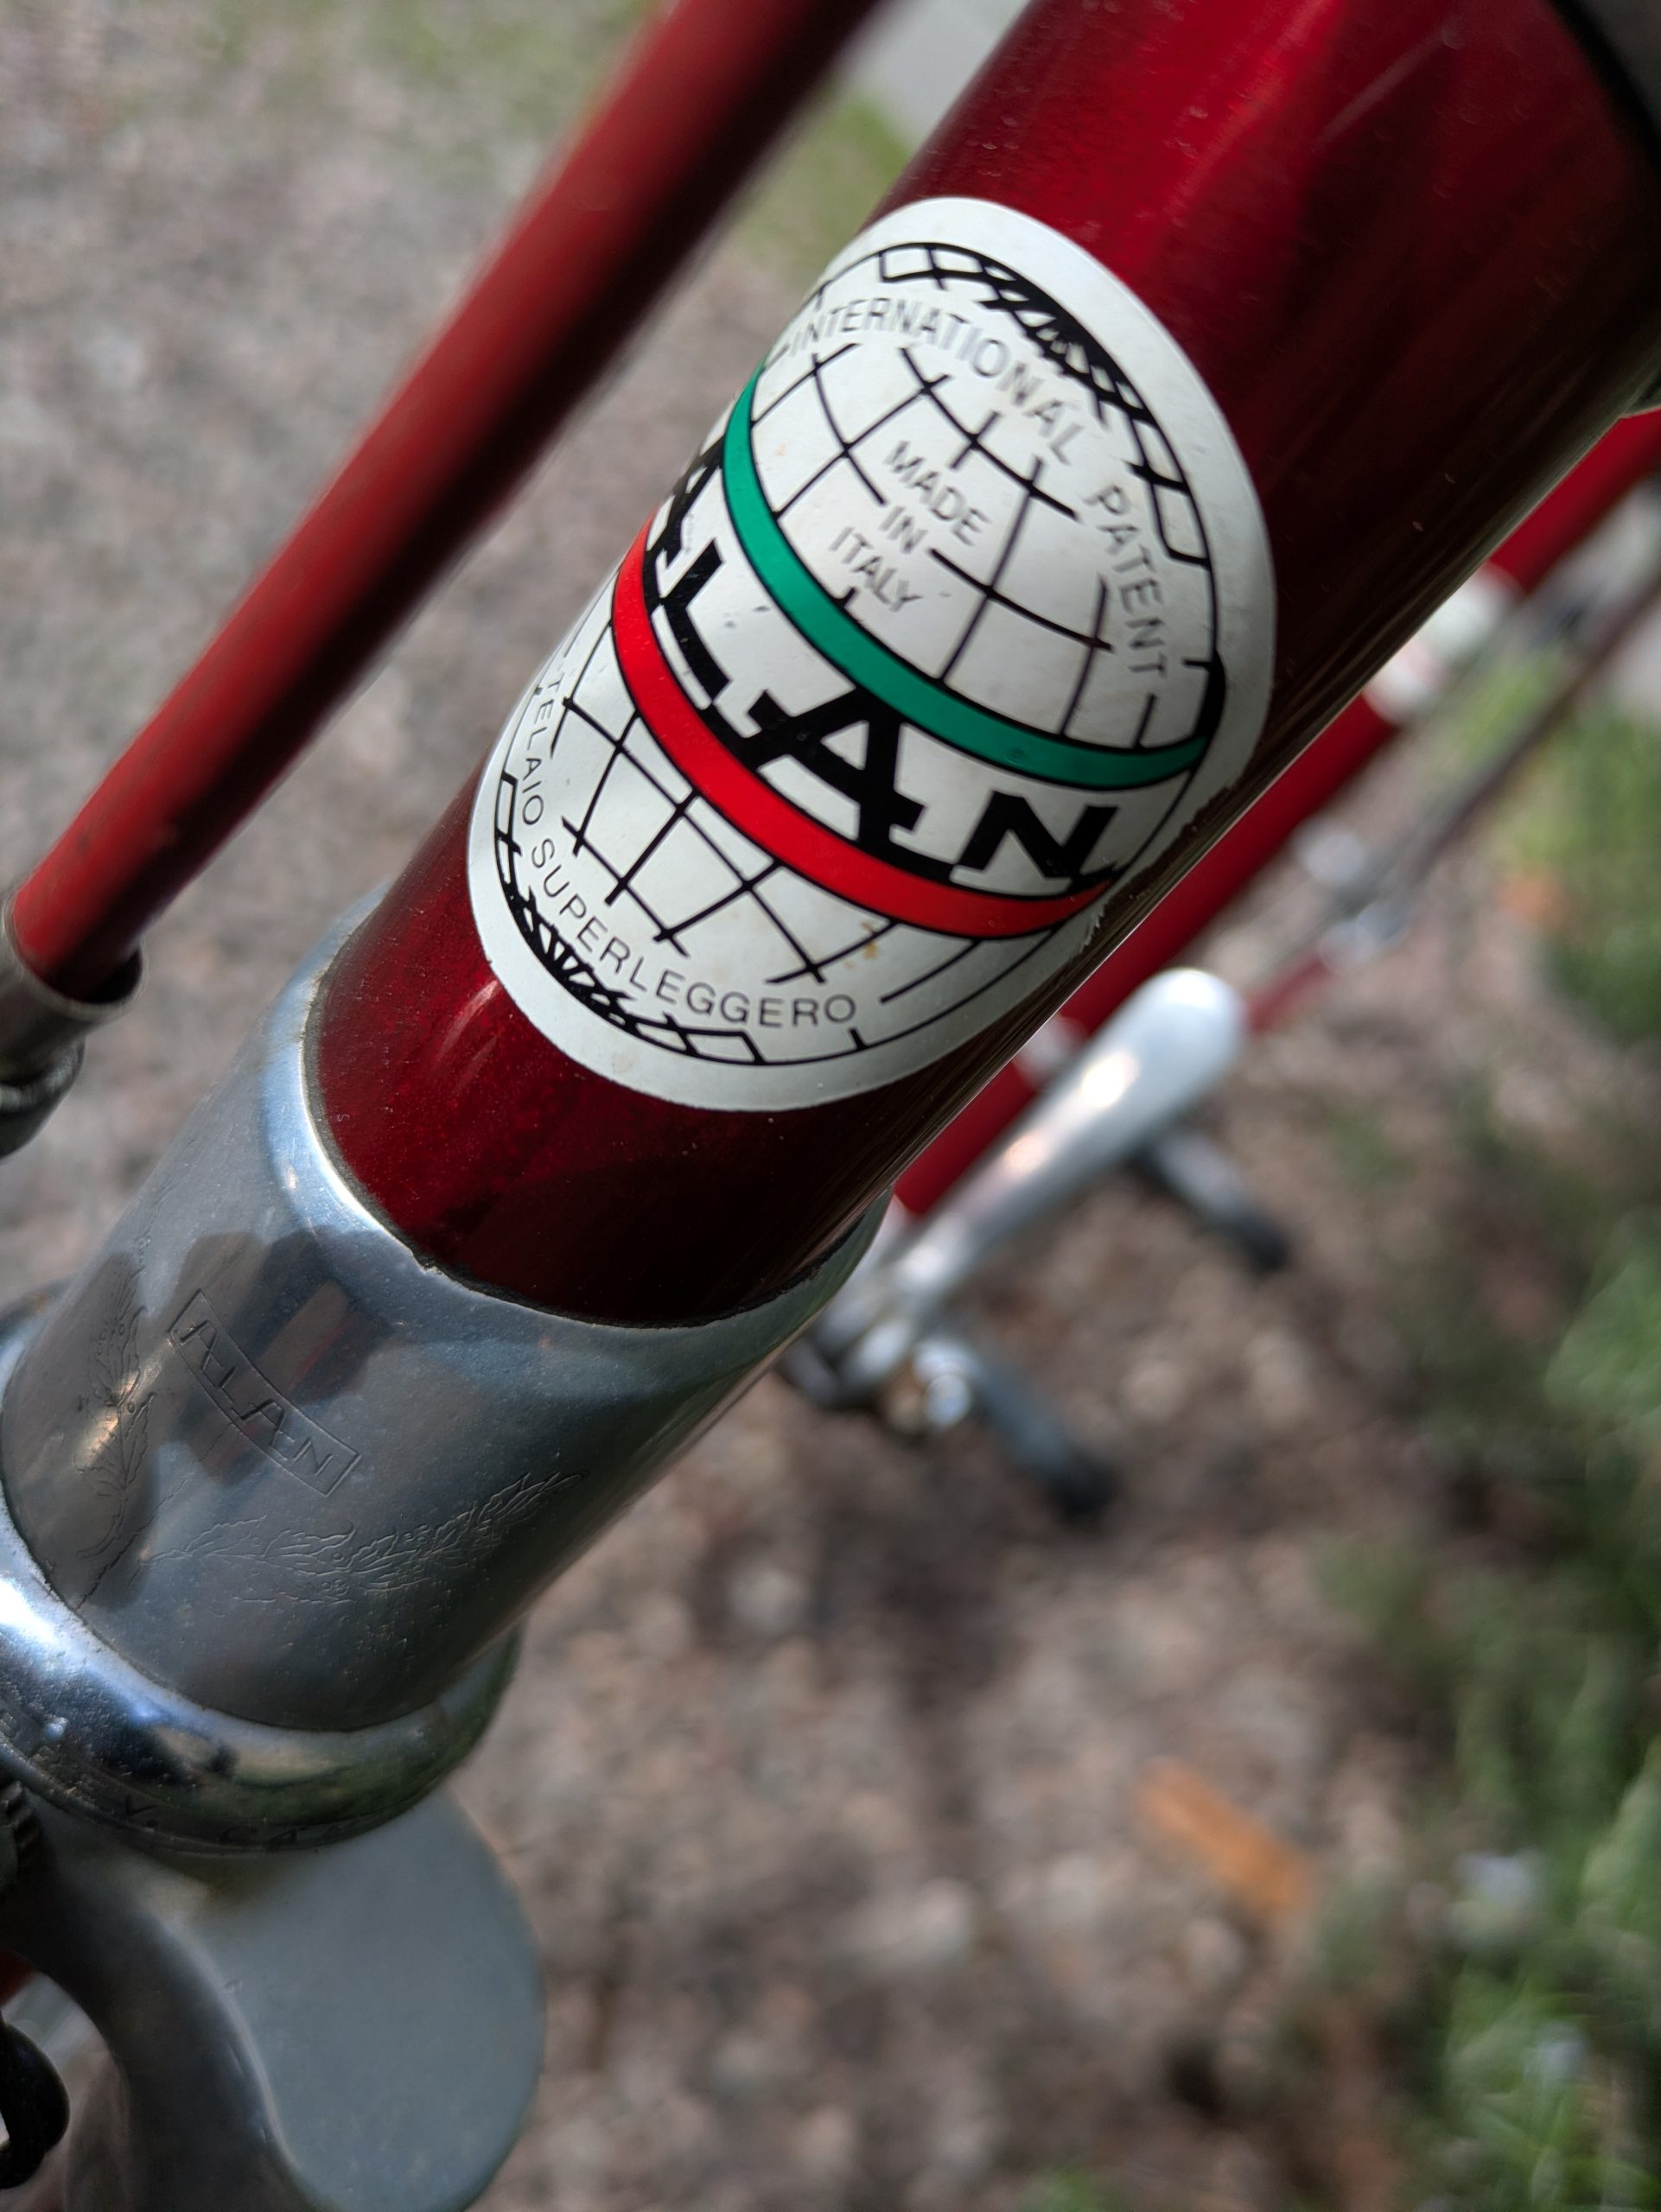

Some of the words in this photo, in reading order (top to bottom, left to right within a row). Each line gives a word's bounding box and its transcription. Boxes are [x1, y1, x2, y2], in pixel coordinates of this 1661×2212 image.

[789, 296, 1085, 467] INTERNATIONAL
[1080, 481, 1169, 679] PATENT
[878, 505, 929, 554] IN
[883, 441, 993, 547] MADE
[828, 527, 924, 613] ITALY
[643, 434, 1123, 892] ALAN
[522, 673, 565, 825] TELAIO
[531, 838, 857, 1027] SUPERLEGGERO
[179, 1319, 335, 1478] ALAN
